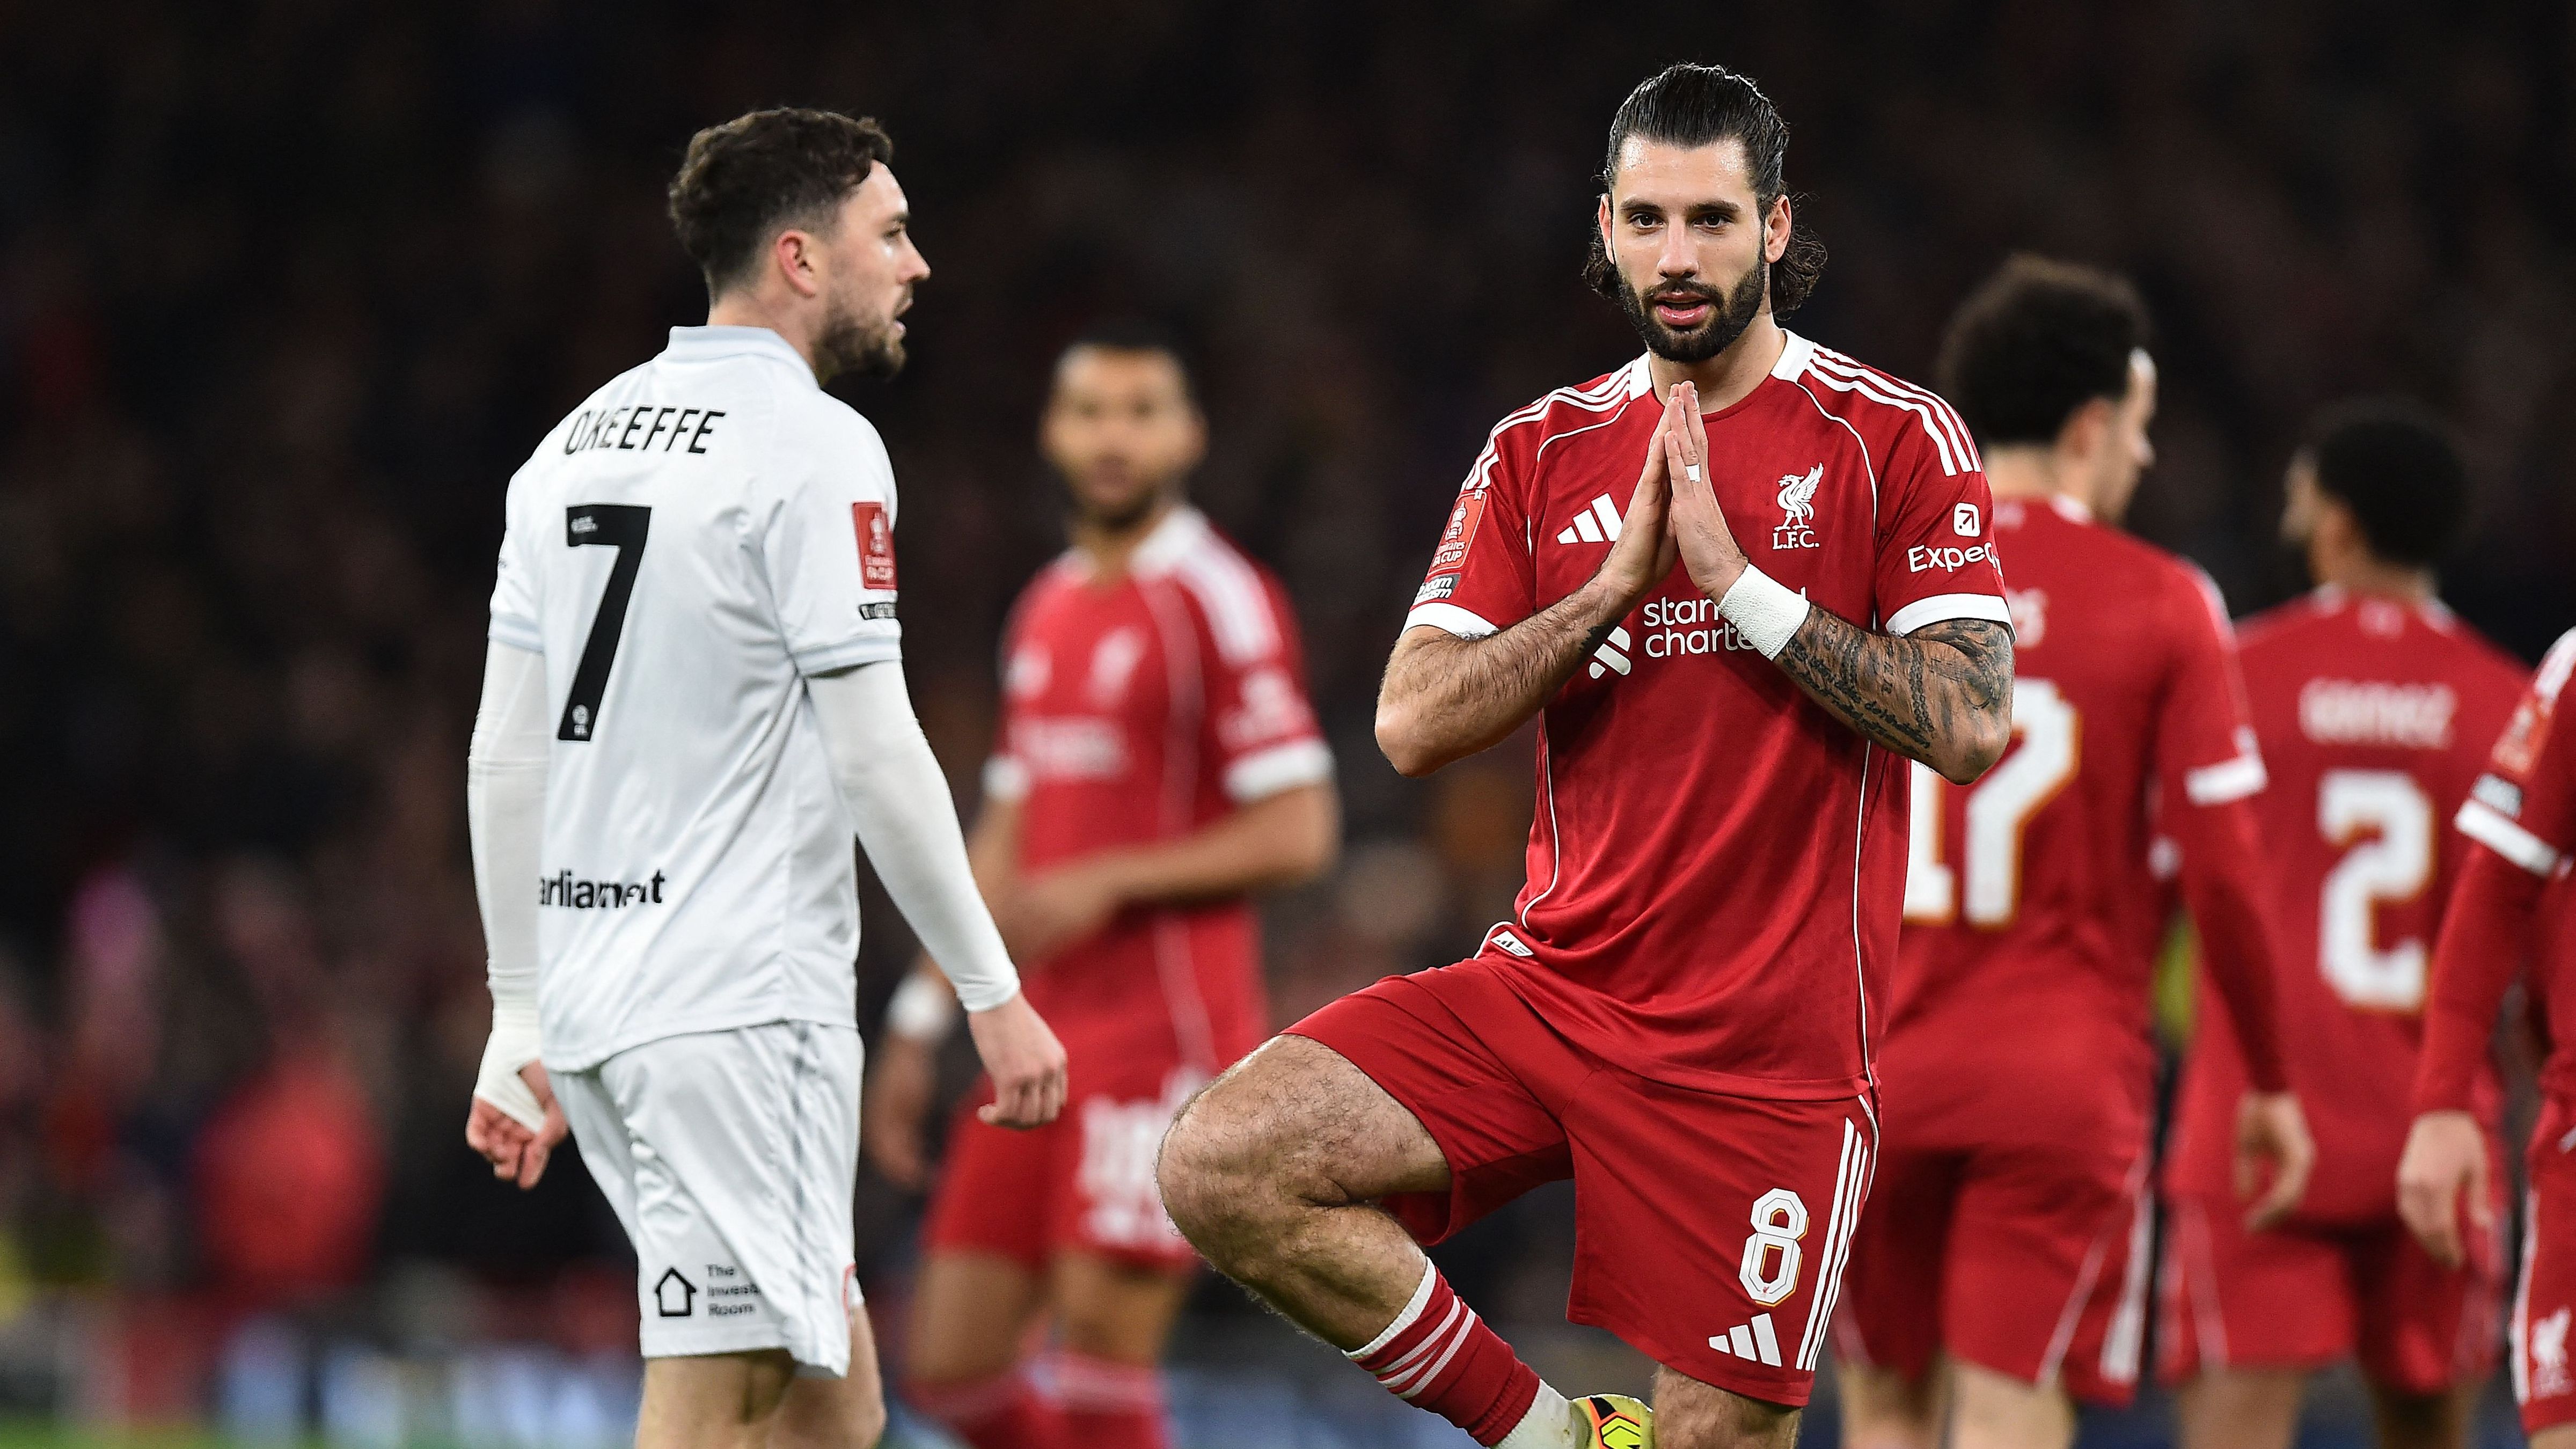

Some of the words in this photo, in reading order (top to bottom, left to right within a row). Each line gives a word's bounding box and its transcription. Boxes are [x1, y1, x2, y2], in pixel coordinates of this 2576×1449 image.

[1441, 550, 1463, 564] CUP
[1773, 530, 1820, 550] L.F.C.
[558, 504, 652, 741] 7
[1645, 623, 1757, 657] charte
[2317, 769, 2433, 1011] 2
[1739, 1188, 1809, 1307] 8
